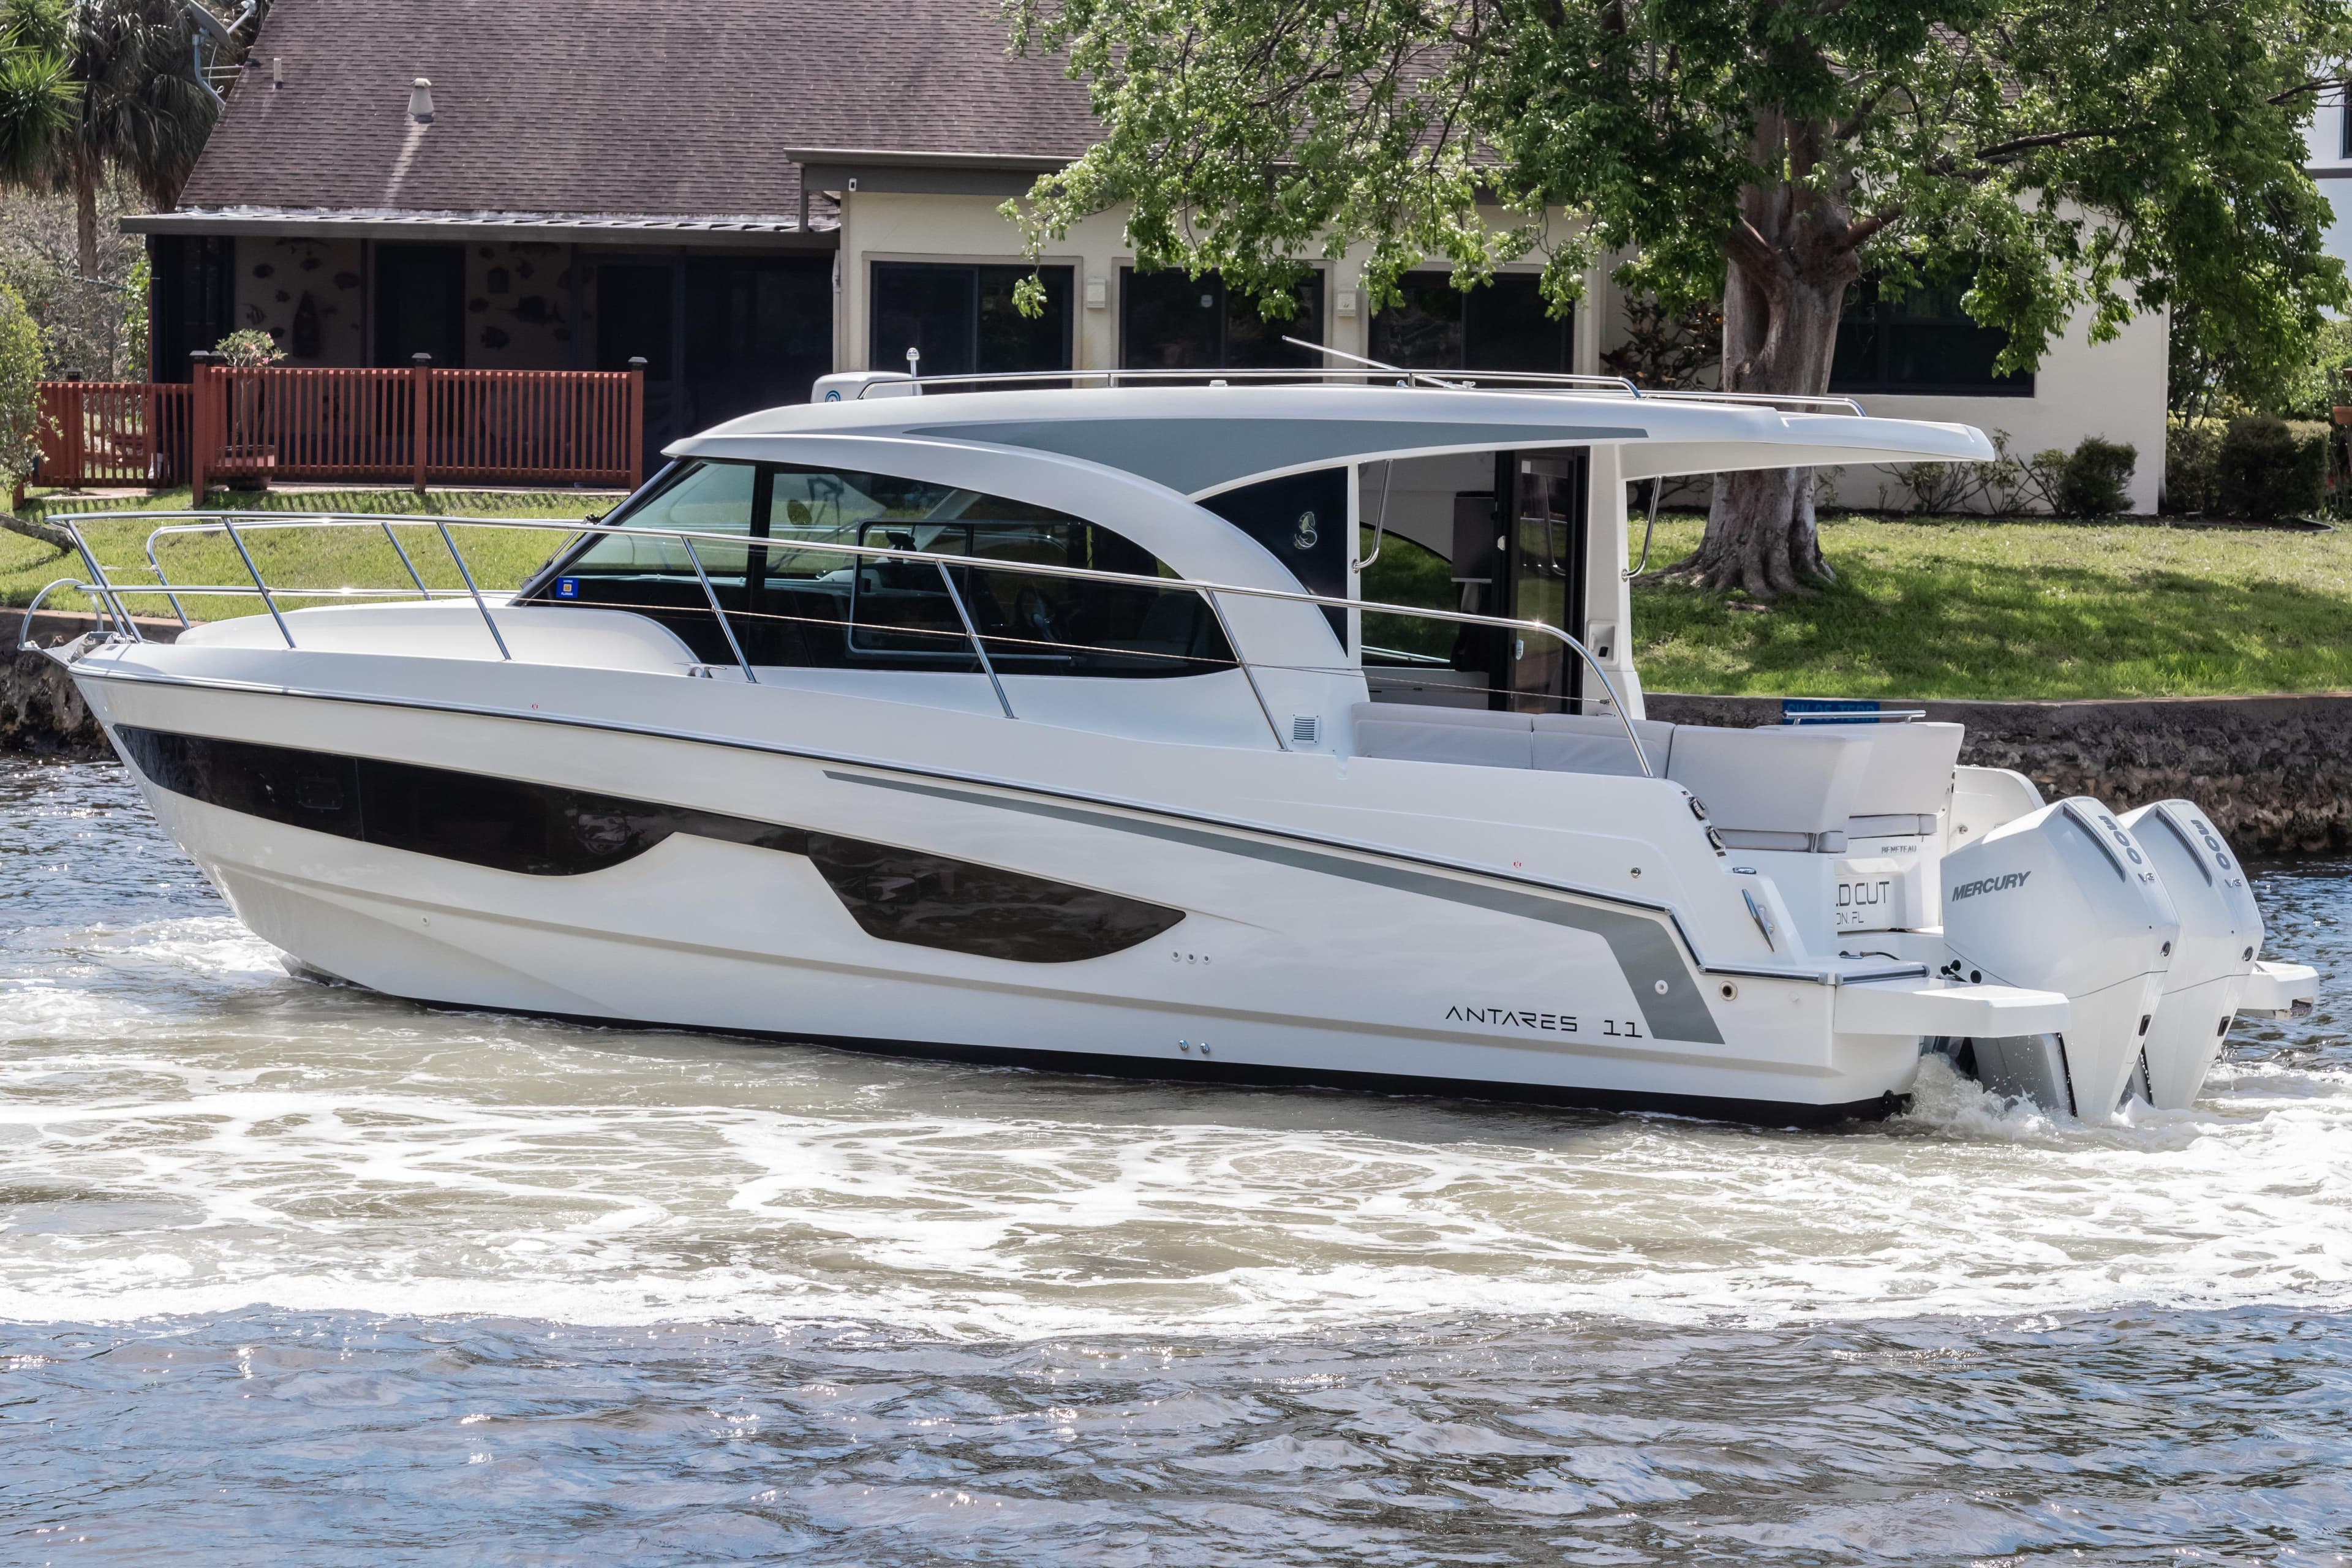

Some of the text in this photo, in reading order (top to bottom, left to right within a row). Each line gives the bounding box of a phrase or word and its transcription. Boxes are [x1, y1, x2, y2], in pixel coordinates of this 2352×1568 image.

[1882, 845, 1917, 854] BENETEAU
[2098, 815, 2142, 865] 300
[2190, 820, 2231, 870] 300
[1855, 881, 1890, 905] CUT
[1952, 870, 2032, 902] MERCURY
[1852, 911, 1864, 924] FL
[1445, 1005, 1643, 1038] ANTARES 11
